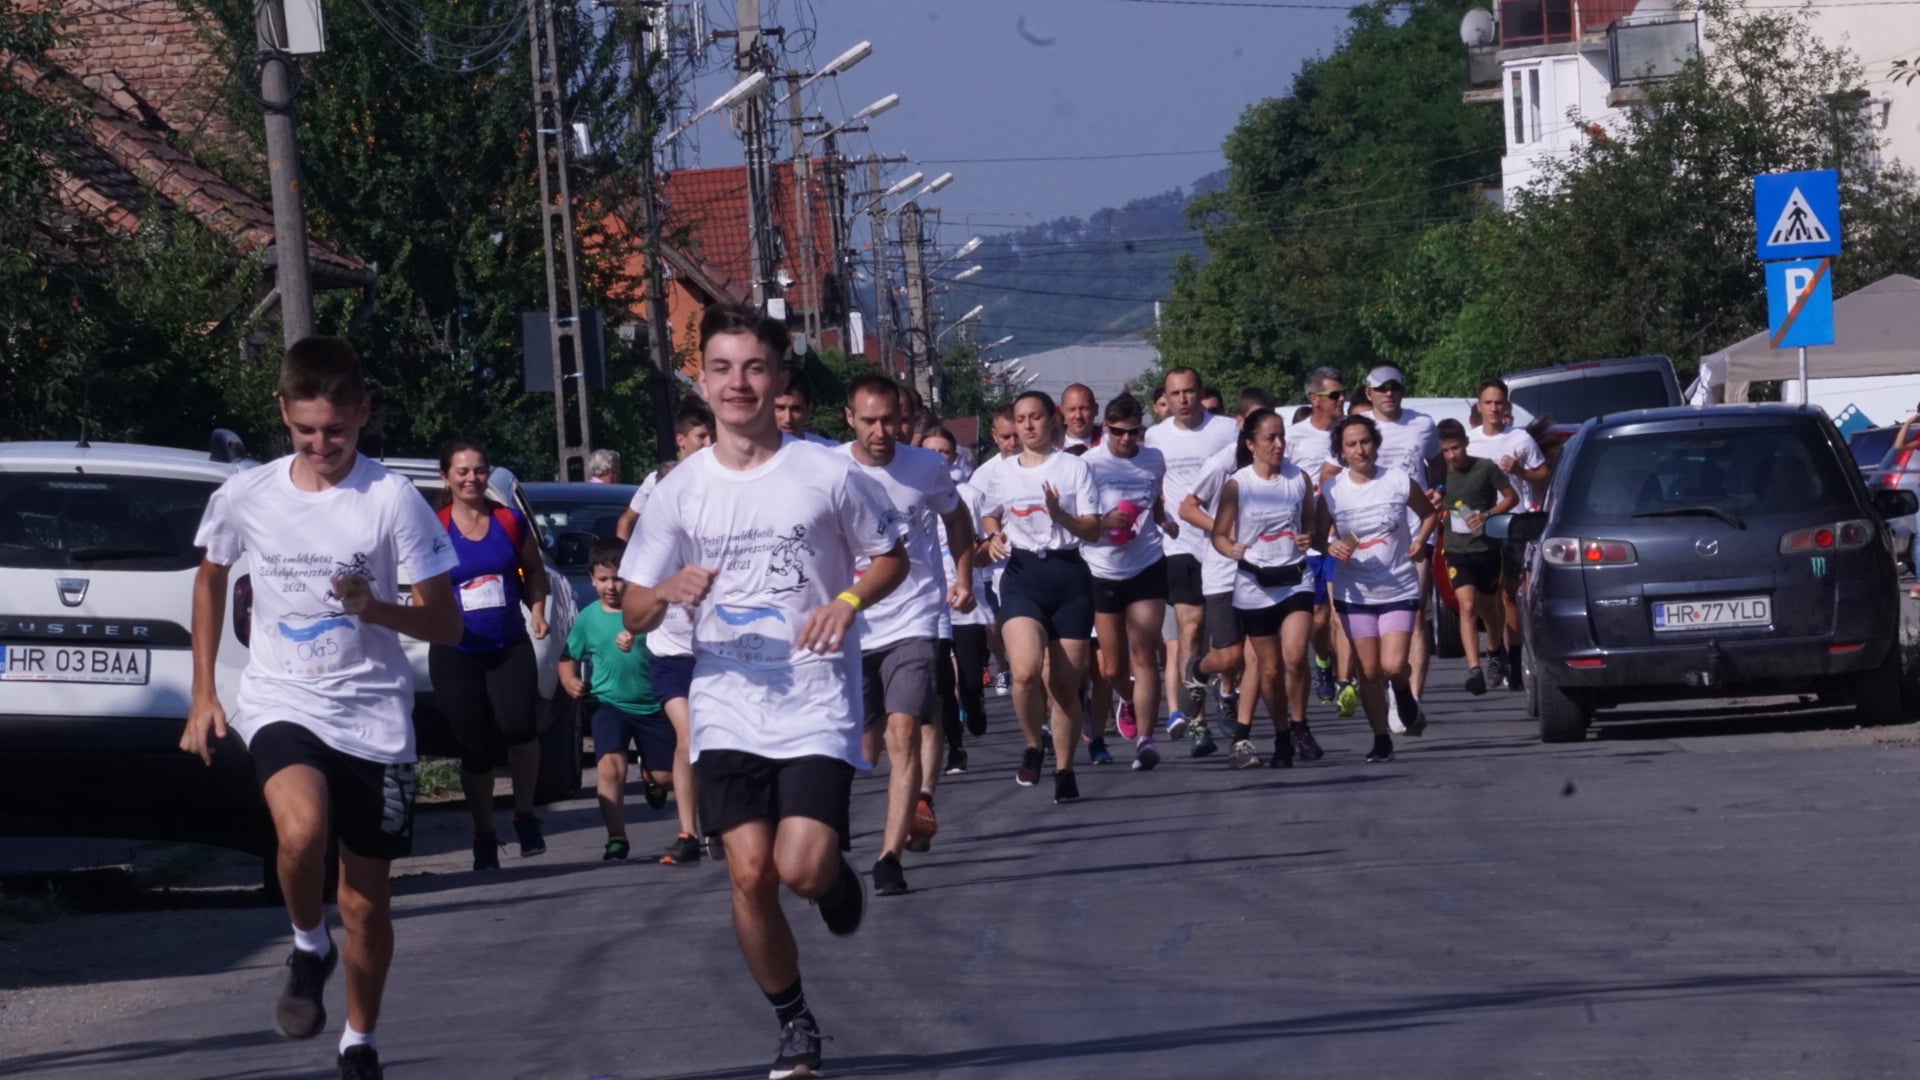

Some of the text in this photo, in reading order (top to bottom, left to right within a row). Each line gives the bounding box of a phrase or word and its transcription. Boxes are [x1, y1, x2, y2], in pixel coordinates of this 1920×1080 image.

[1785, 268, 1815, 315] P
[726, 560, 751, 571] 2021
[282, 582, 306, 593] 2021
[1666, 605, 1694, 624] HR
[1701, 603, 1724, 622] 77
[1727, 600, 1766, 620] YLD
[9, 648, 139, 674] HR 03 BAA
